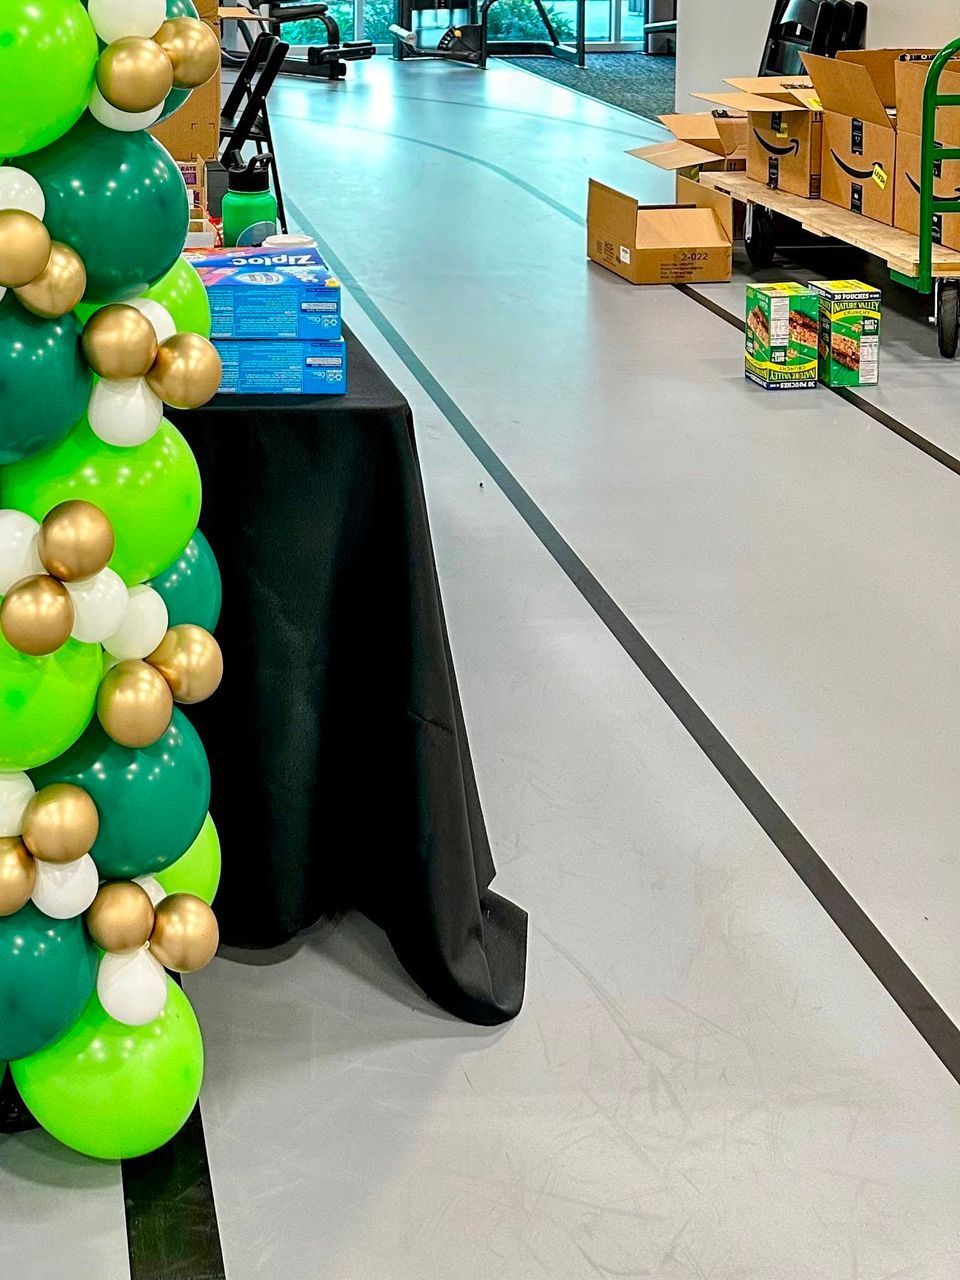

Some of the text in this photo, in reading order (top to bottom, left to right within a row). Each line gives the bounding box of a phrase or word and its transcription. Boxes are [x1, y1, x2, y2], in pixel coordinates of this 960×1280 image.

[232, 254, 315, 266] Ziploc
[833, 302, 857, 313] NATURE
[858, 301, 879, 312] VALLEY
[769, 370, 790, 380] VALLEY
[791, 369, 815, 379] NATURE
